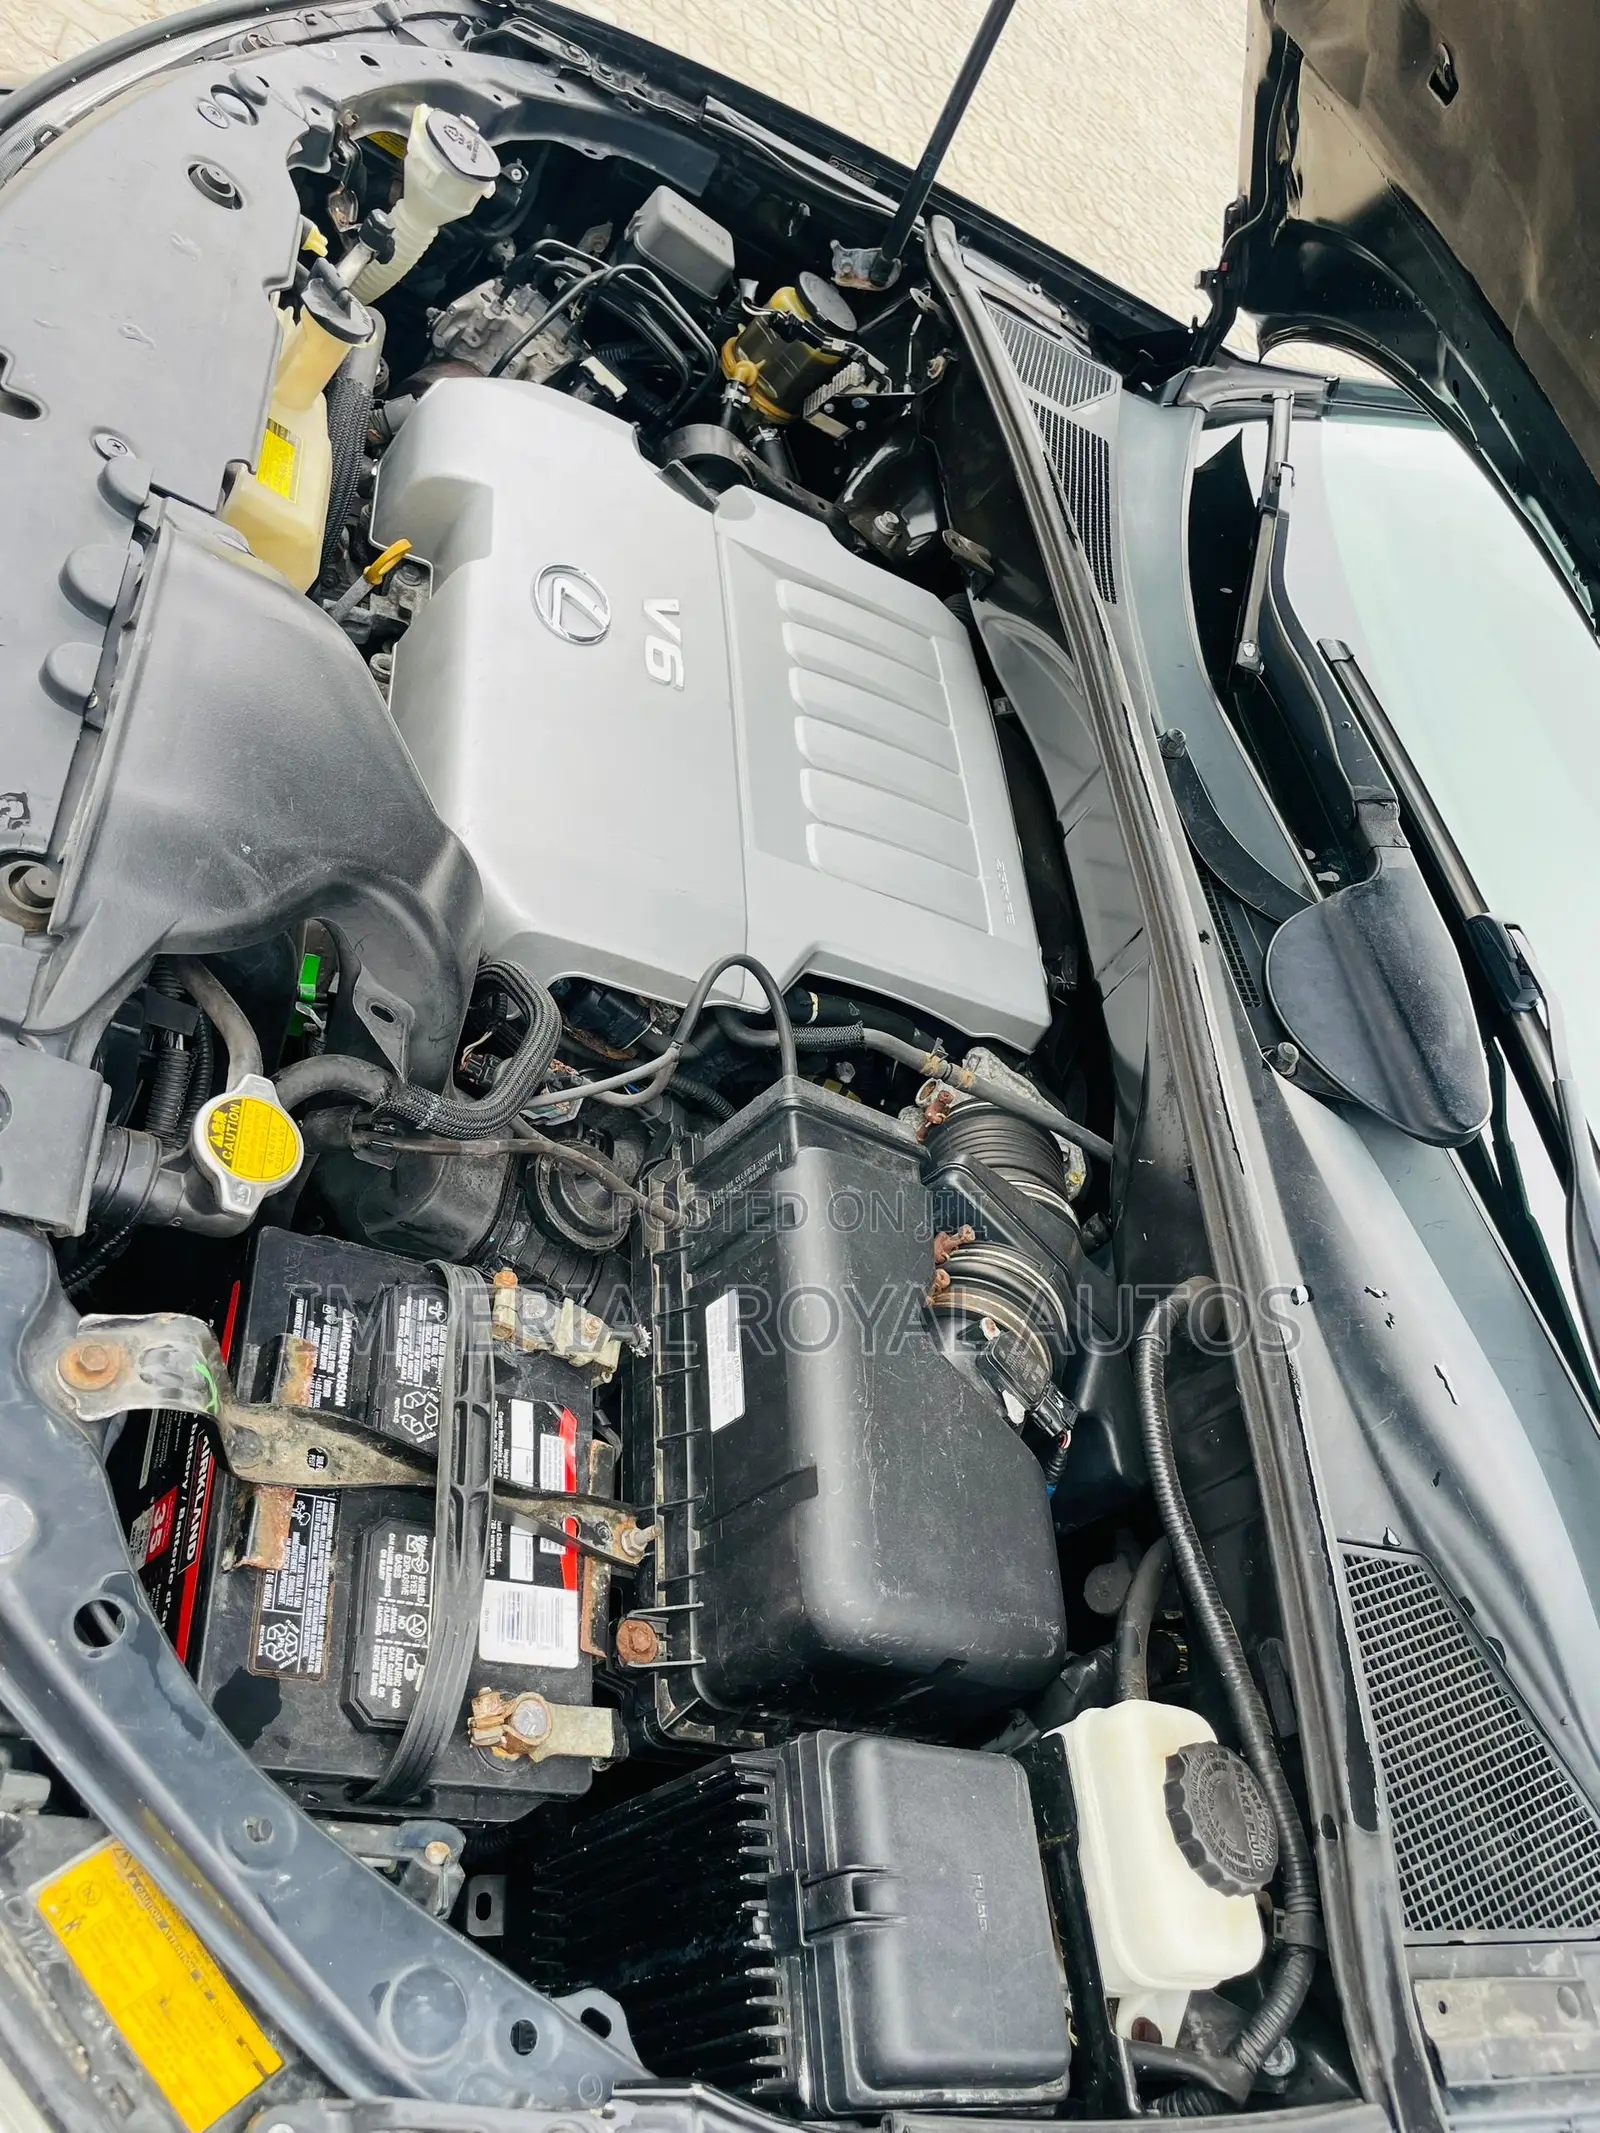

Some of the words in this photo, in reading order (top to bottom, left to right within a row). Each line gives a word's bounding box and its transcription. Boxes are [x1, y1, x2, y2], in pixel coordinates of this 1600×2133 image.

[642, 598, 684, 691] V6
[222, 1103, 239, 1160] CAUTION
[294, 1314, 302, 1329] HORS
[335, 1319, 352, 1406] DANGER/POISON
[181, 1424, 198, 1490] battery
[149, 1502, 167, 1554] 35
[168, 1506, 185, 1585] Batterie
[265, 1575, 273, 1583] DE
[393, 1554, 402, 1578] GASES
[401, 1555, 411, 1596] EXPLOSIVE
[409, 1574, 418, 1595] EYES
[263, 1584, 272, 1609] NIVEAU.
[416, 1576, 425, 1603] SHIELD
[398, 1615, 405, 1629] NO
[378, 1646, 388, 1685] BLINDNESS
[386, 1663, 394, 1687] CAUSE
[393, 1648, 404, 1687] SULFURIC
[378, 1687, 386, 1698] OR
[392, 1688, 401, 1709] ACID
[1231, 1760, 1252, 1816] BRAKE
[1245, 1821, 1265, 1870] FLUID
[971, 1871, 988, 1932] FUSE
